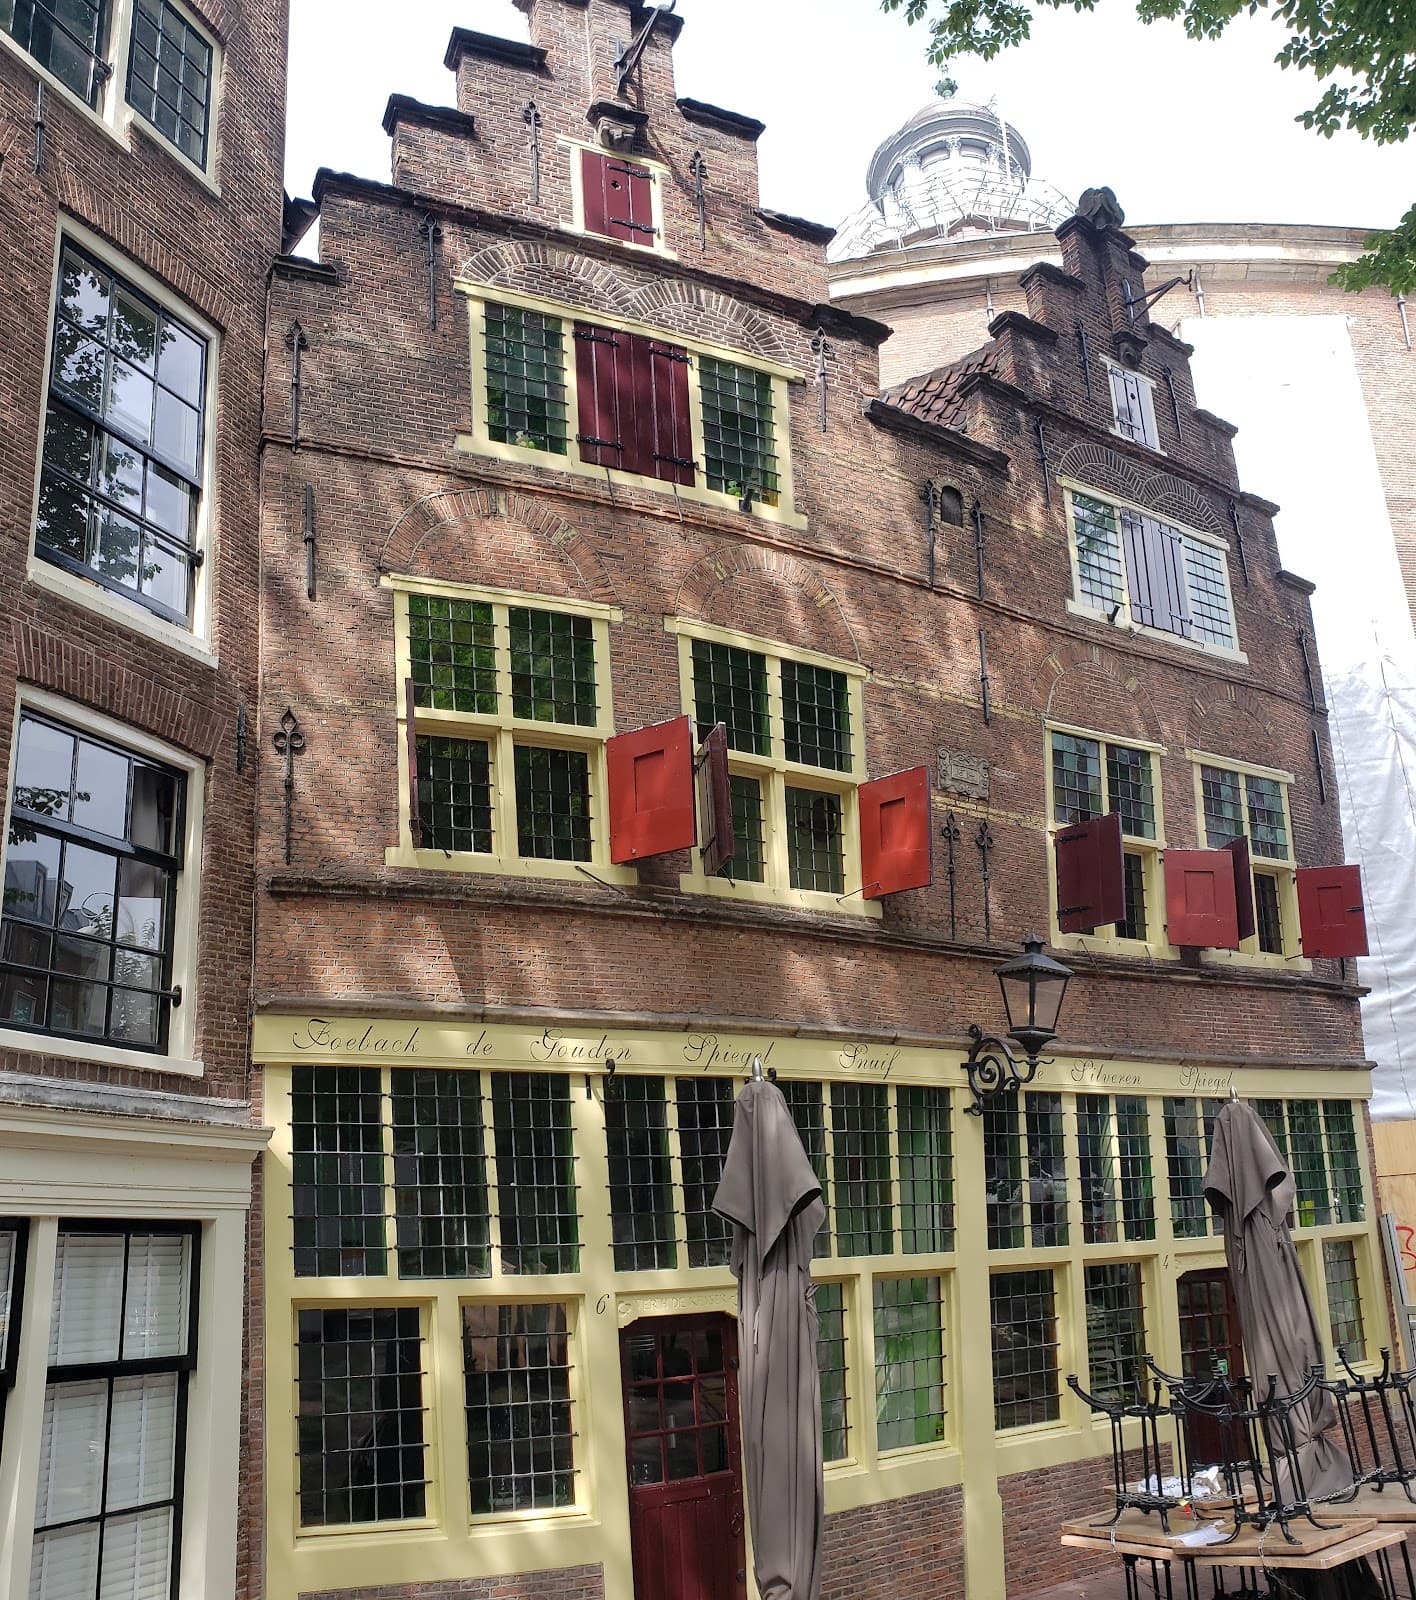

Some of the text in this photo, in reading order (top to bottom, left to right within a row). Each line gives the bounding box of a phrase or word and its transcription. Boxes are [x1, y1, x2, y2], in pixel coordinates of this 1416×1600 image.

[465, 1029, 493, 1056] de
[530, 1027, 632, 1060] Gouden
[1179, 1065, 1233, 1095] Spiegel
[1162, 1254, 1169, 1270] 4
[595, 1293, 610, 1315] 6
